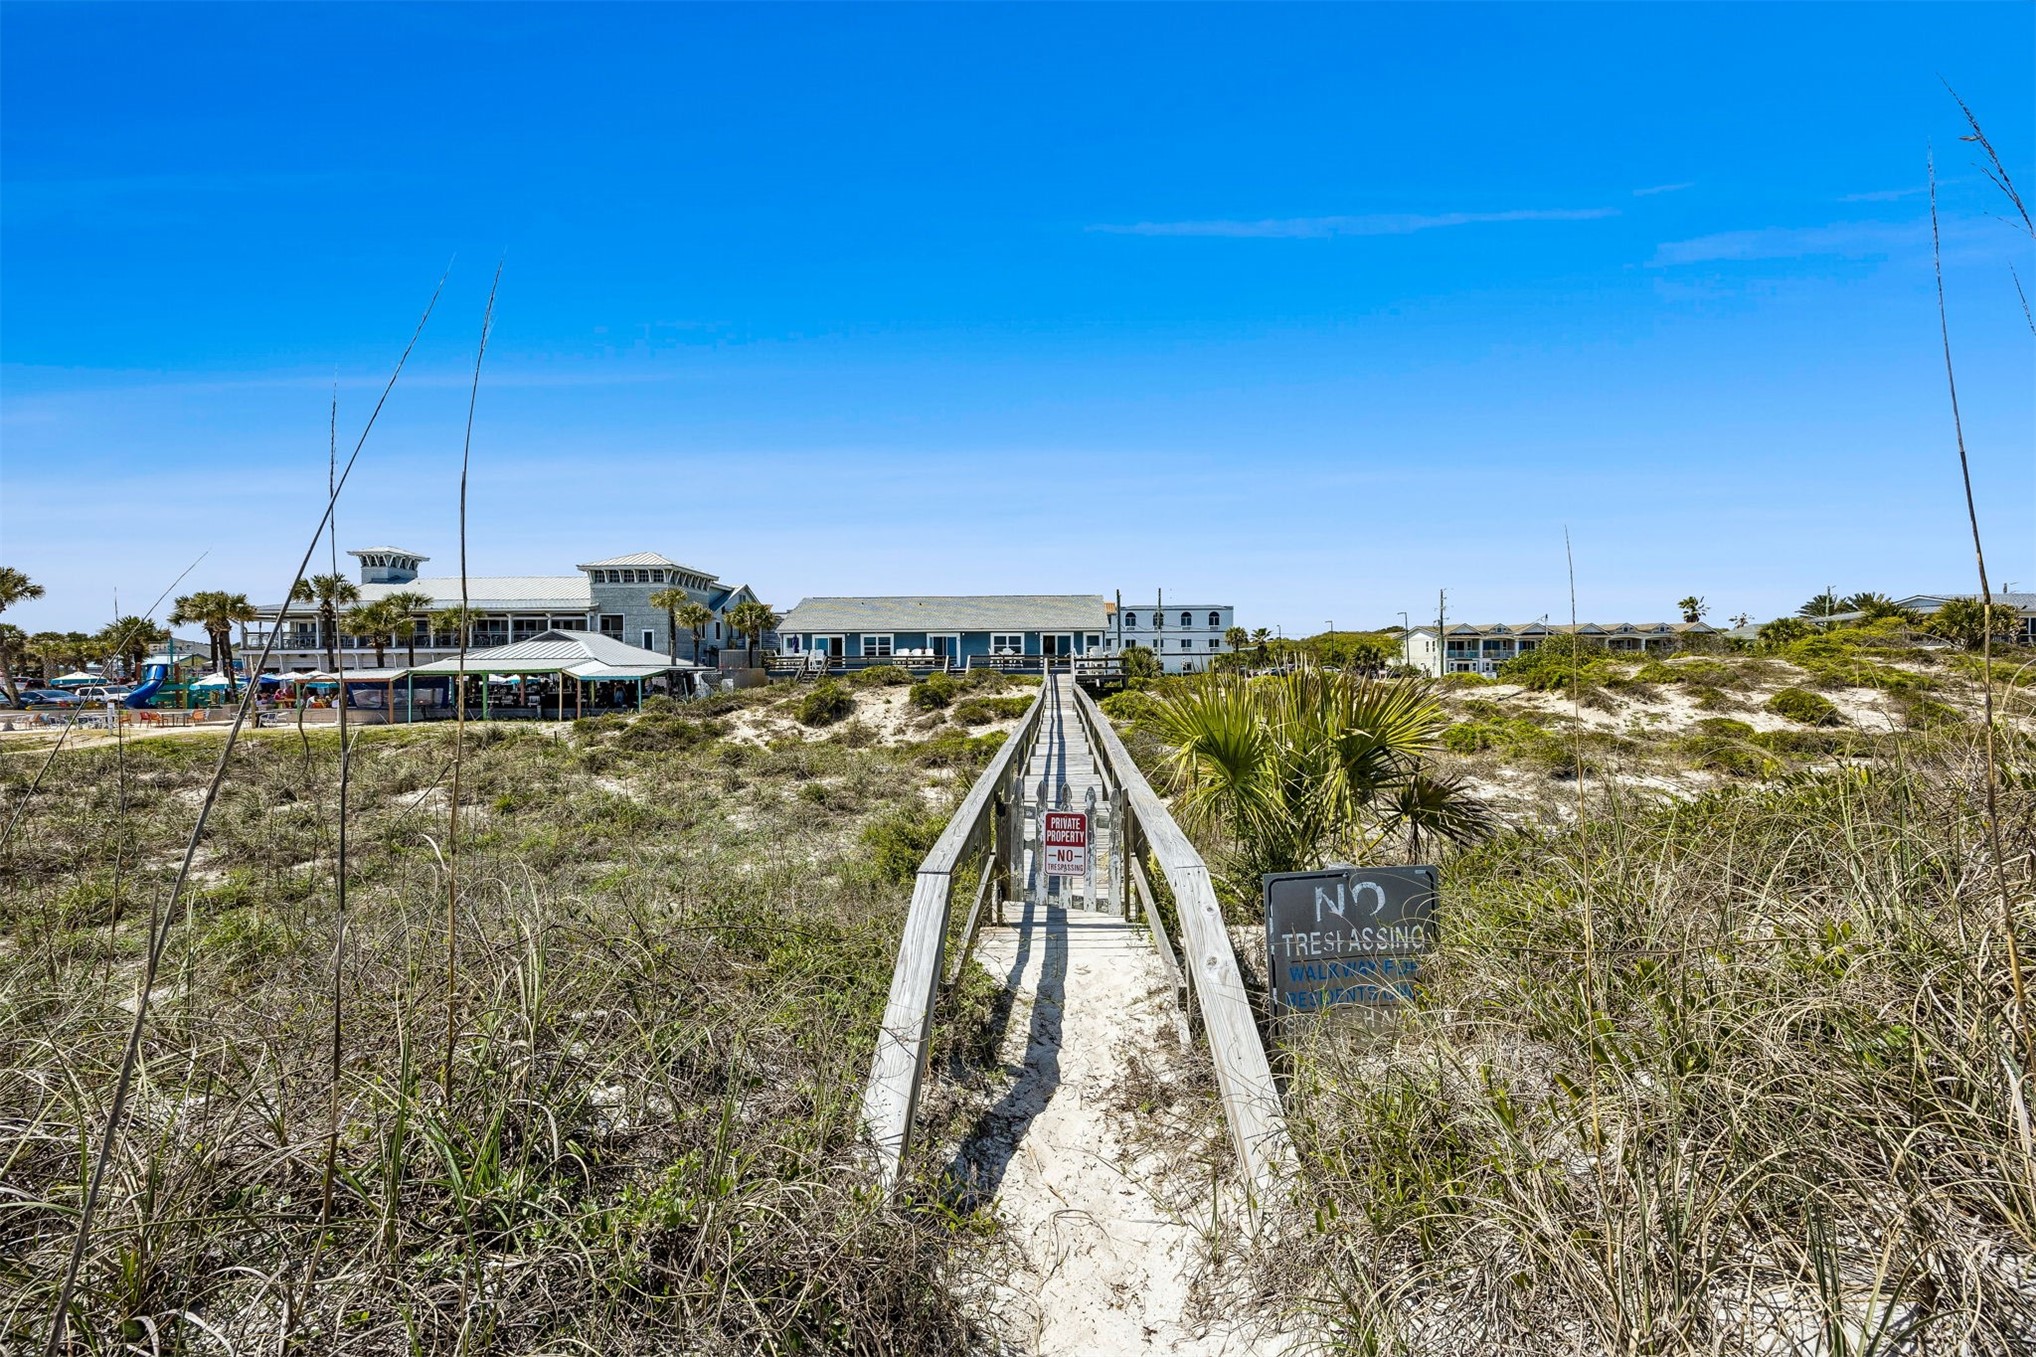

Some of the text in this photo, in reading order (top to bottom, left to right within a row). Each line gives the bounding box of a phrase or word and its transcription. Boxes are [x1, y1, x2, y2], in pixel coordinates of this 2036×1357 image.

[1051, 817, 1080, 829] PRIVATE
[1047, 830, 1084, 842] PROPERTY
[1048, 864, 1083, 872] TRESPASSING
[1289, 960, 1377, 982] WALKWAY
